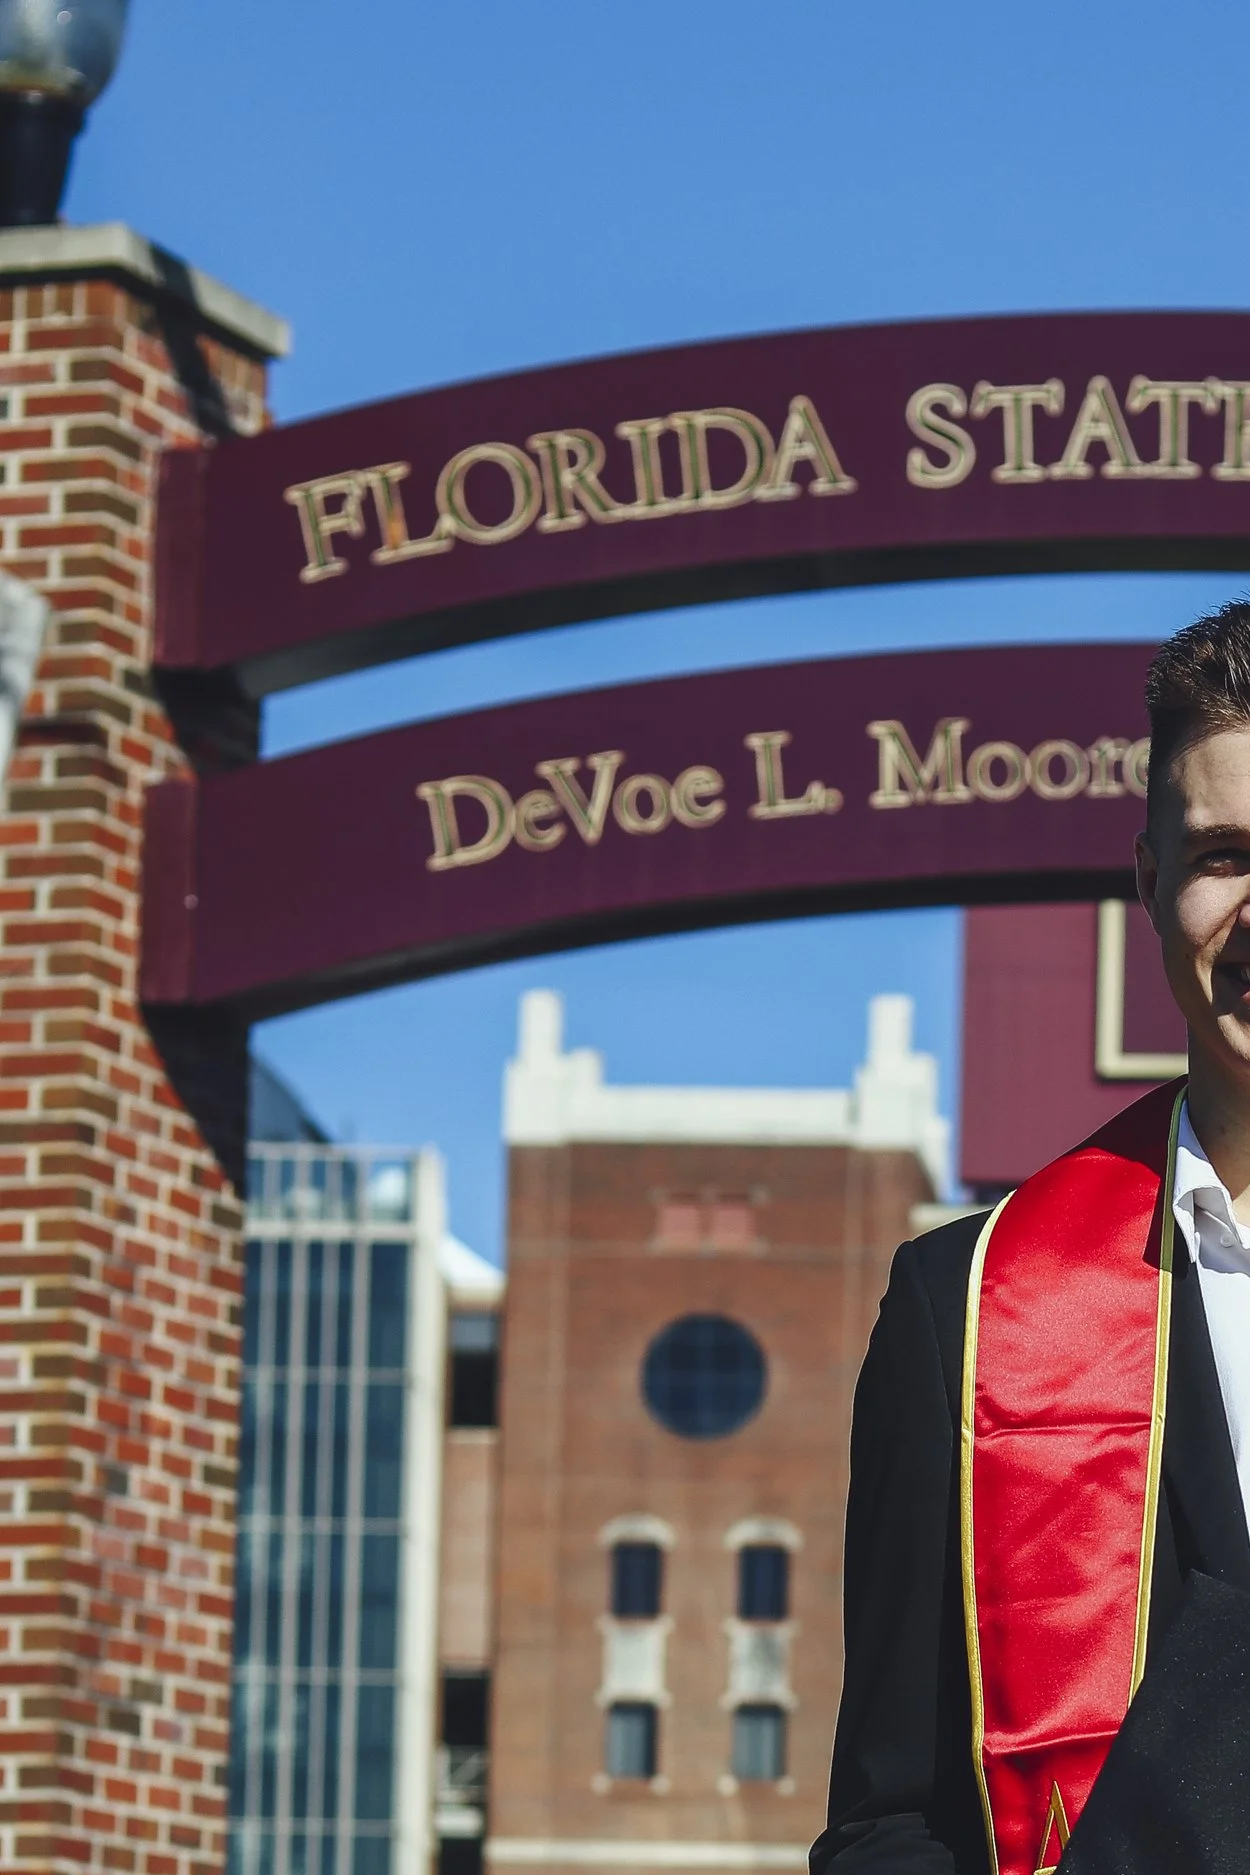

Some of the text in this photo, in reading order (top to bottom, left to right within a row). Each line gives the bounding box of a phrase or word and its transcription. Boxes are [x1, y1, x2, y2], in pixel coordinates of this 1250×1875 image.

[284, 395, 857, 582] FLORIDA
[416, 750, 727, 871] DeVoe
[744, 730, 843, 820] L.
